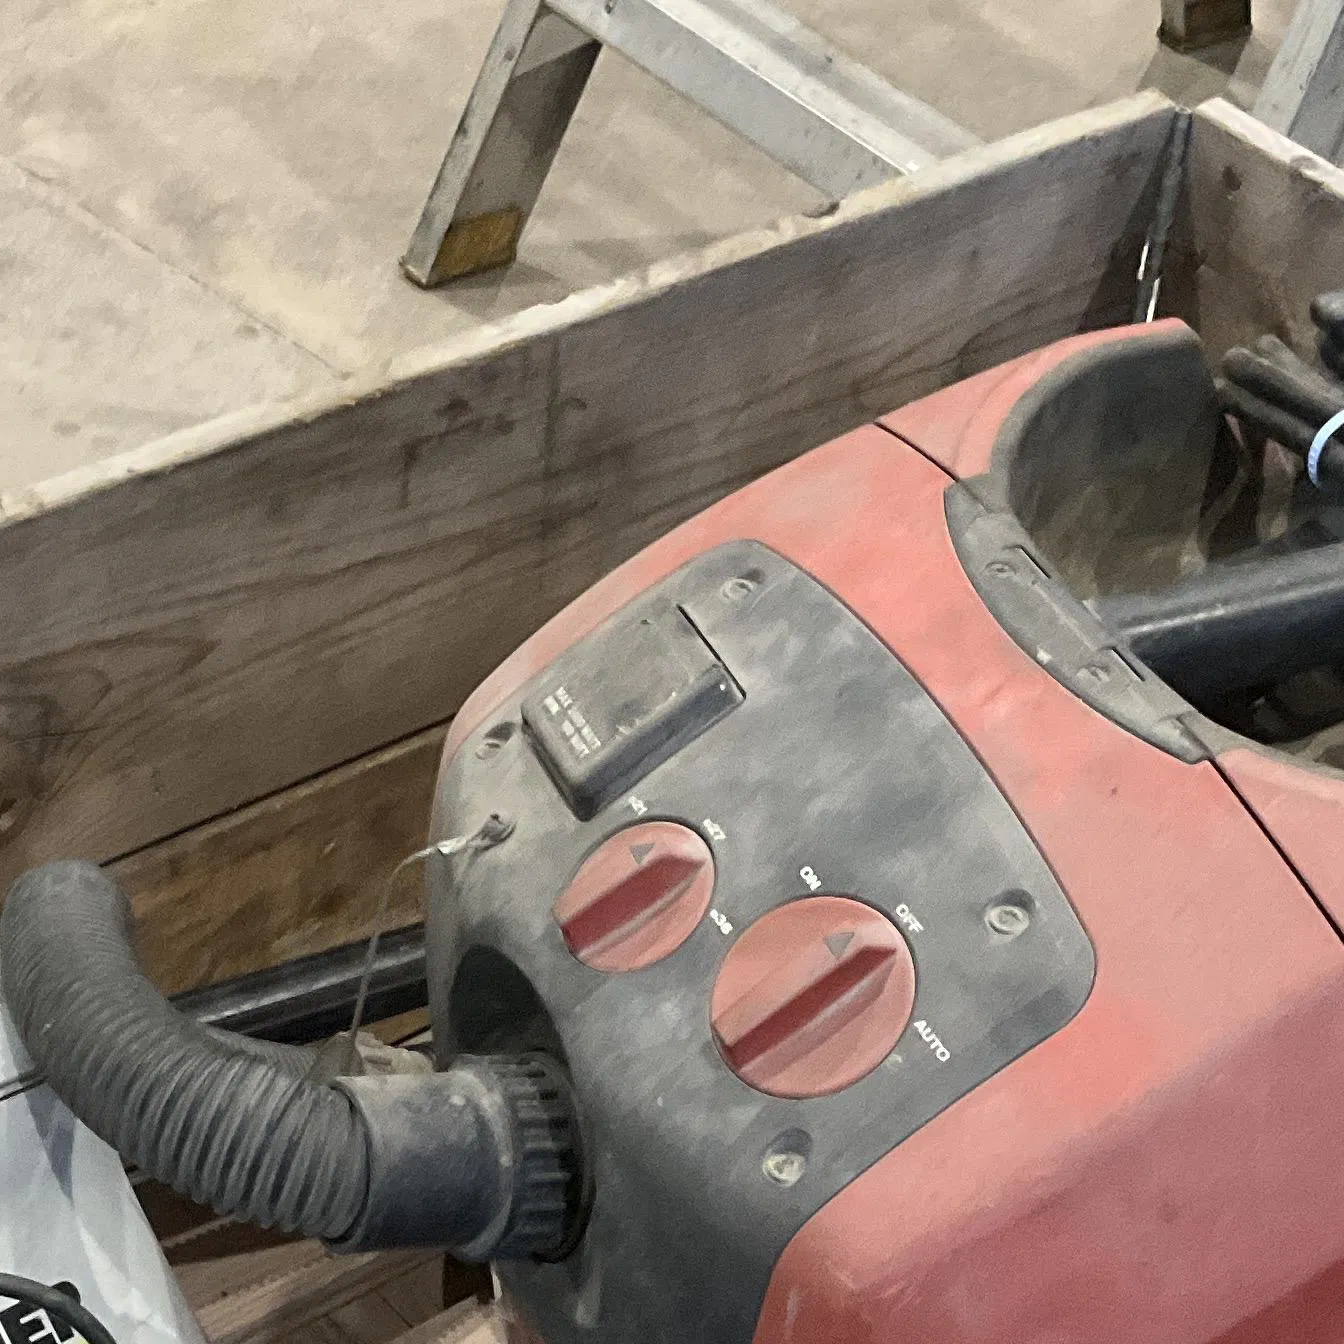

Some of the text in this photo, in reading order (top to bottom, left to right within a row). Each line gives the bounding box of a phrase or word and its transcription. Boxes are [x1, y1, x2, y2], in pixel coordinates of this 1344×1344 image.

[799, 866, 823, 890] ON
[895, 903, 923, 933] OFF
[913, 1018, 952, 1063] AUTO
